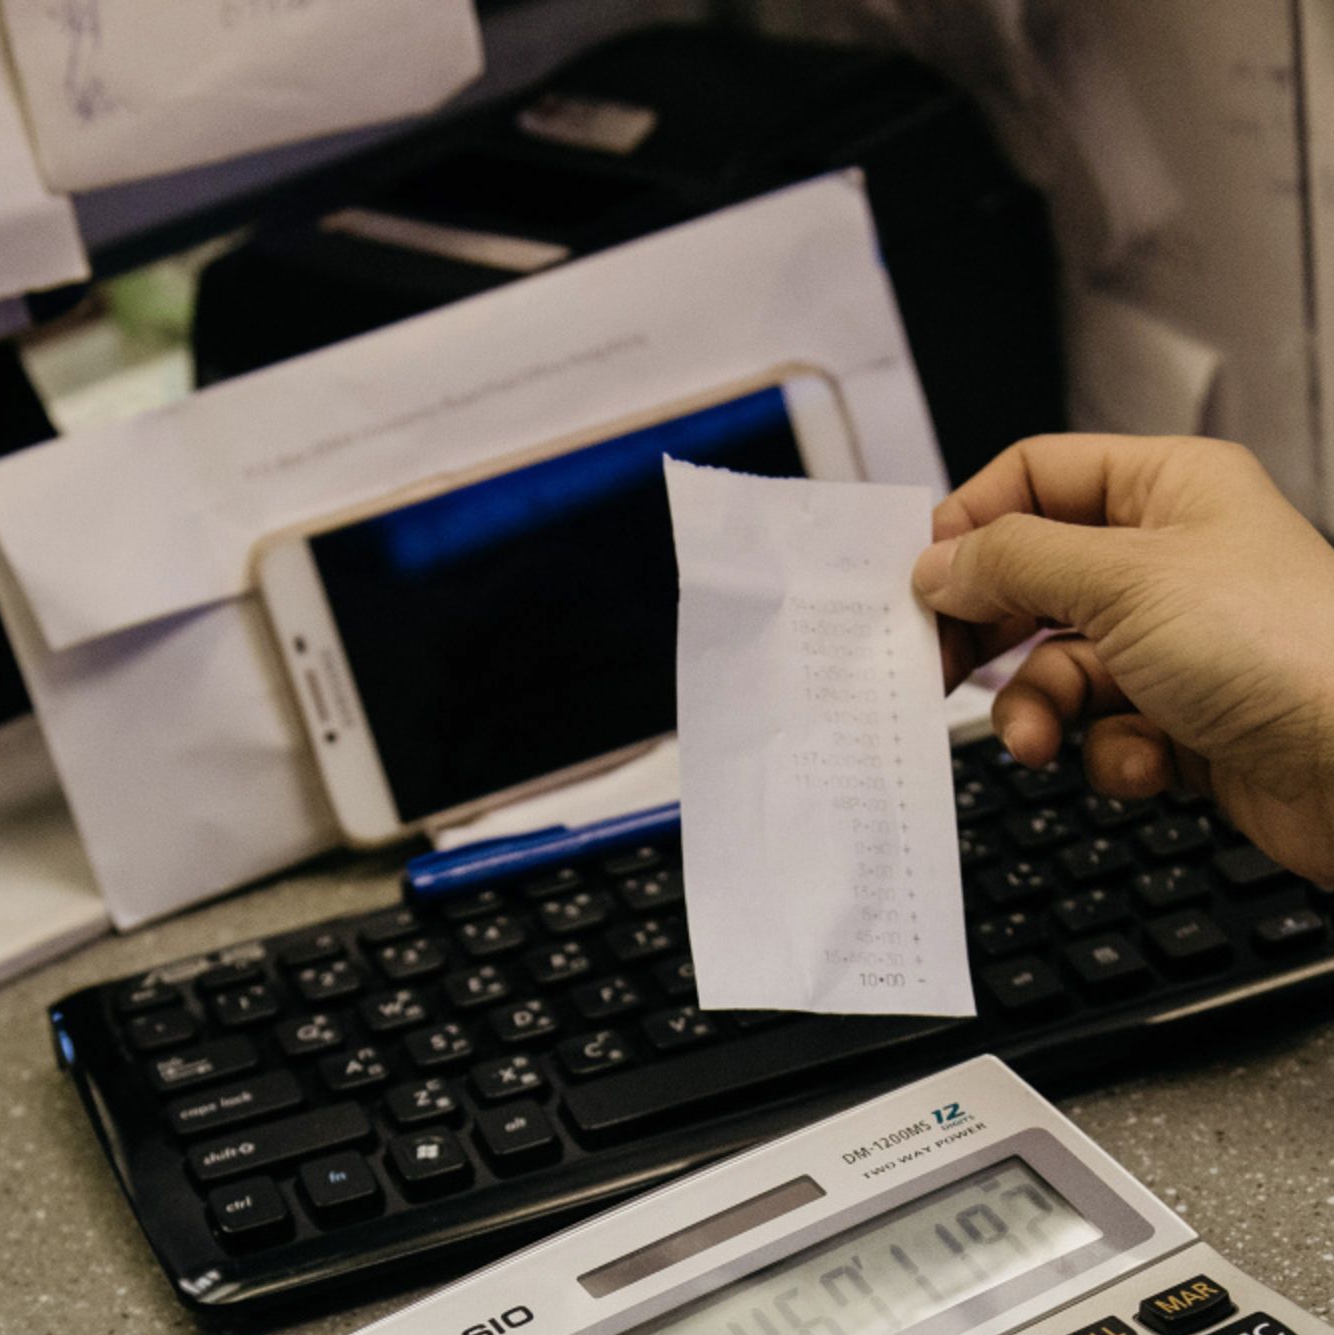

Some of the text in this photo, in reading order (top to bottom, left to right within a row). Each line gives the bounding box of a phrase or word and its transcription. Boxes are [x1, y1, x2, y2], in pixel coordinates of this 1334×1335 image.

[842, 1101, 967, 1166] DM-1200MS 12
[863, 1121, 988, 1180] TWO WAY POWER
[225, 1195, 253, 1214] ctrl
[1154, 1280, 1220, 1315] MAR
